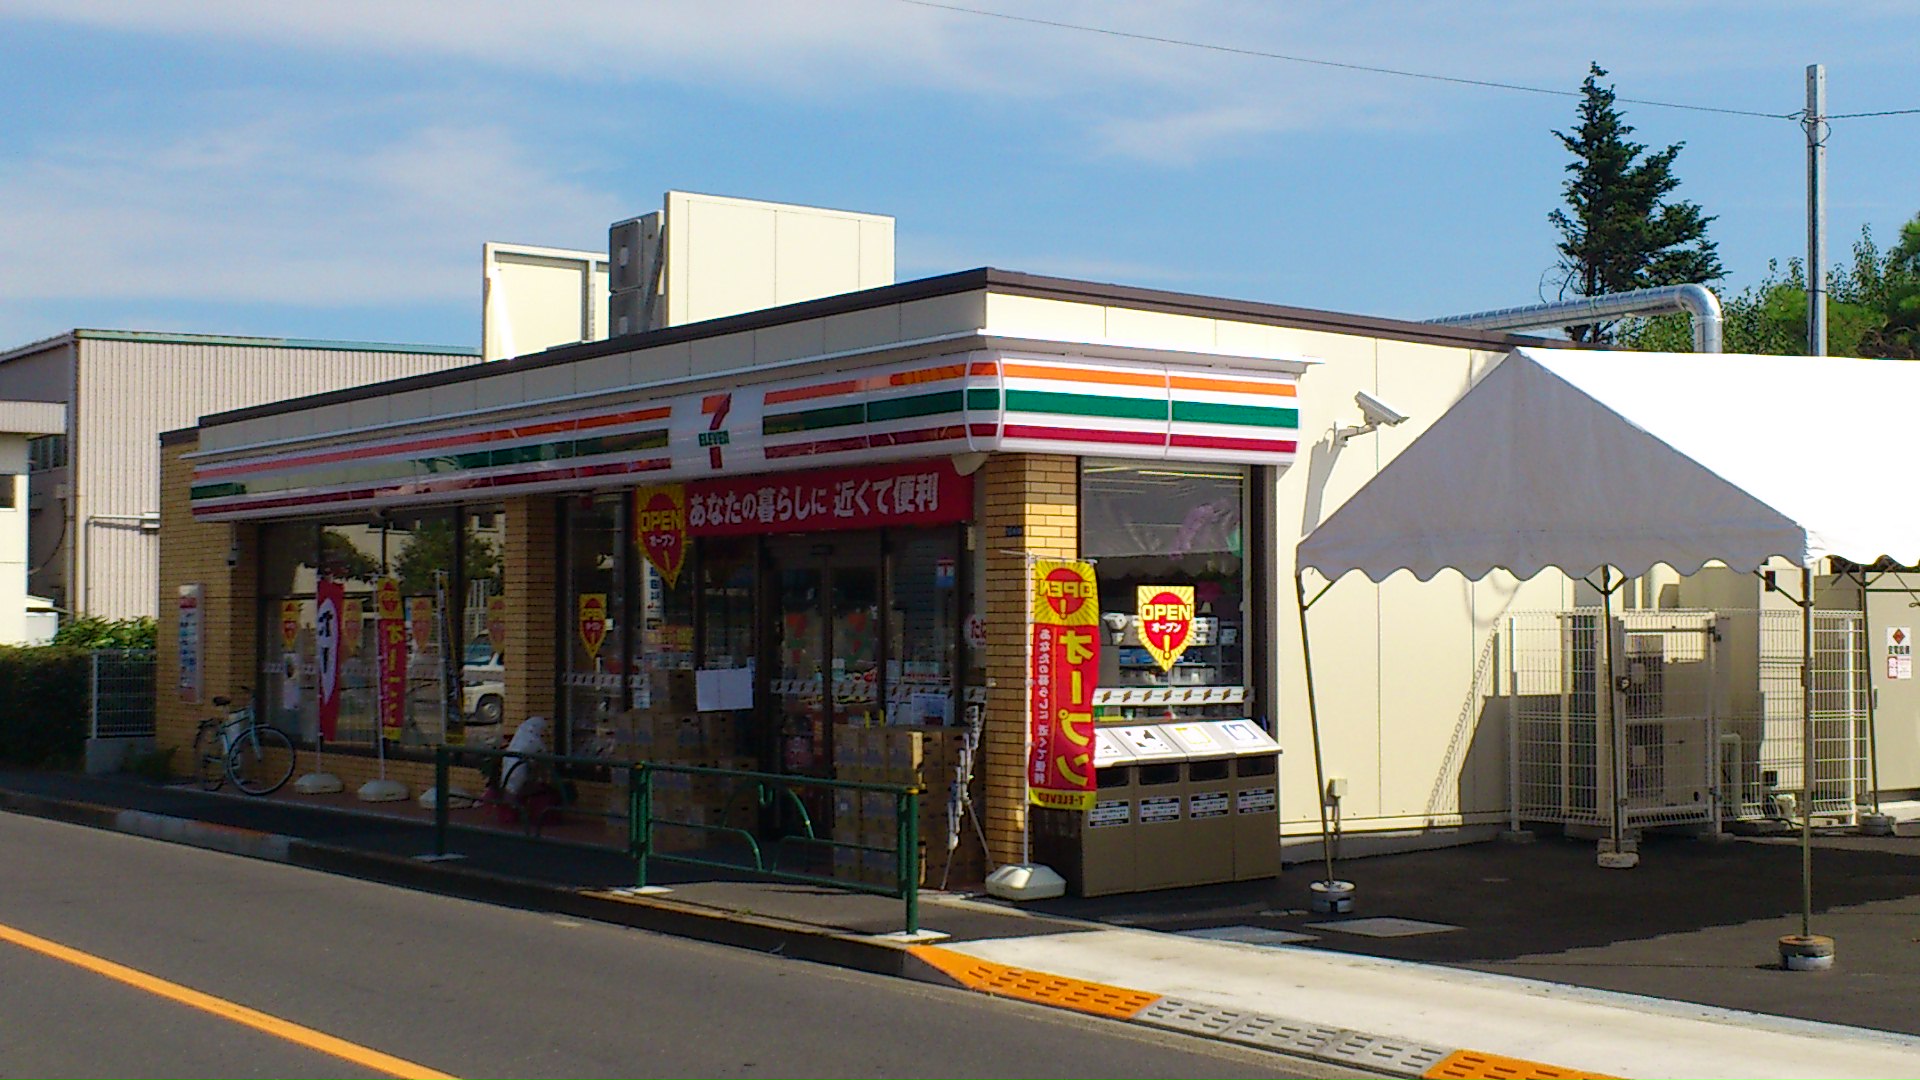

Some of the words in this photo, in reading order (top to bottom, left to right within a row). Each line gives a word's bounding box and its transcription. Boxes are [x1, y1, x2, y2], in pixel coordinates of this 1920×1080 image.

[688, 485, 827, 527] あなたの暮らしに
[833, 472, 940, 518] 近くて便利
[640, 508, 682, 532] OPEN
[1141, 603, 1192, 621] OPEN
[1151, 622, 1182, 633] オープン
